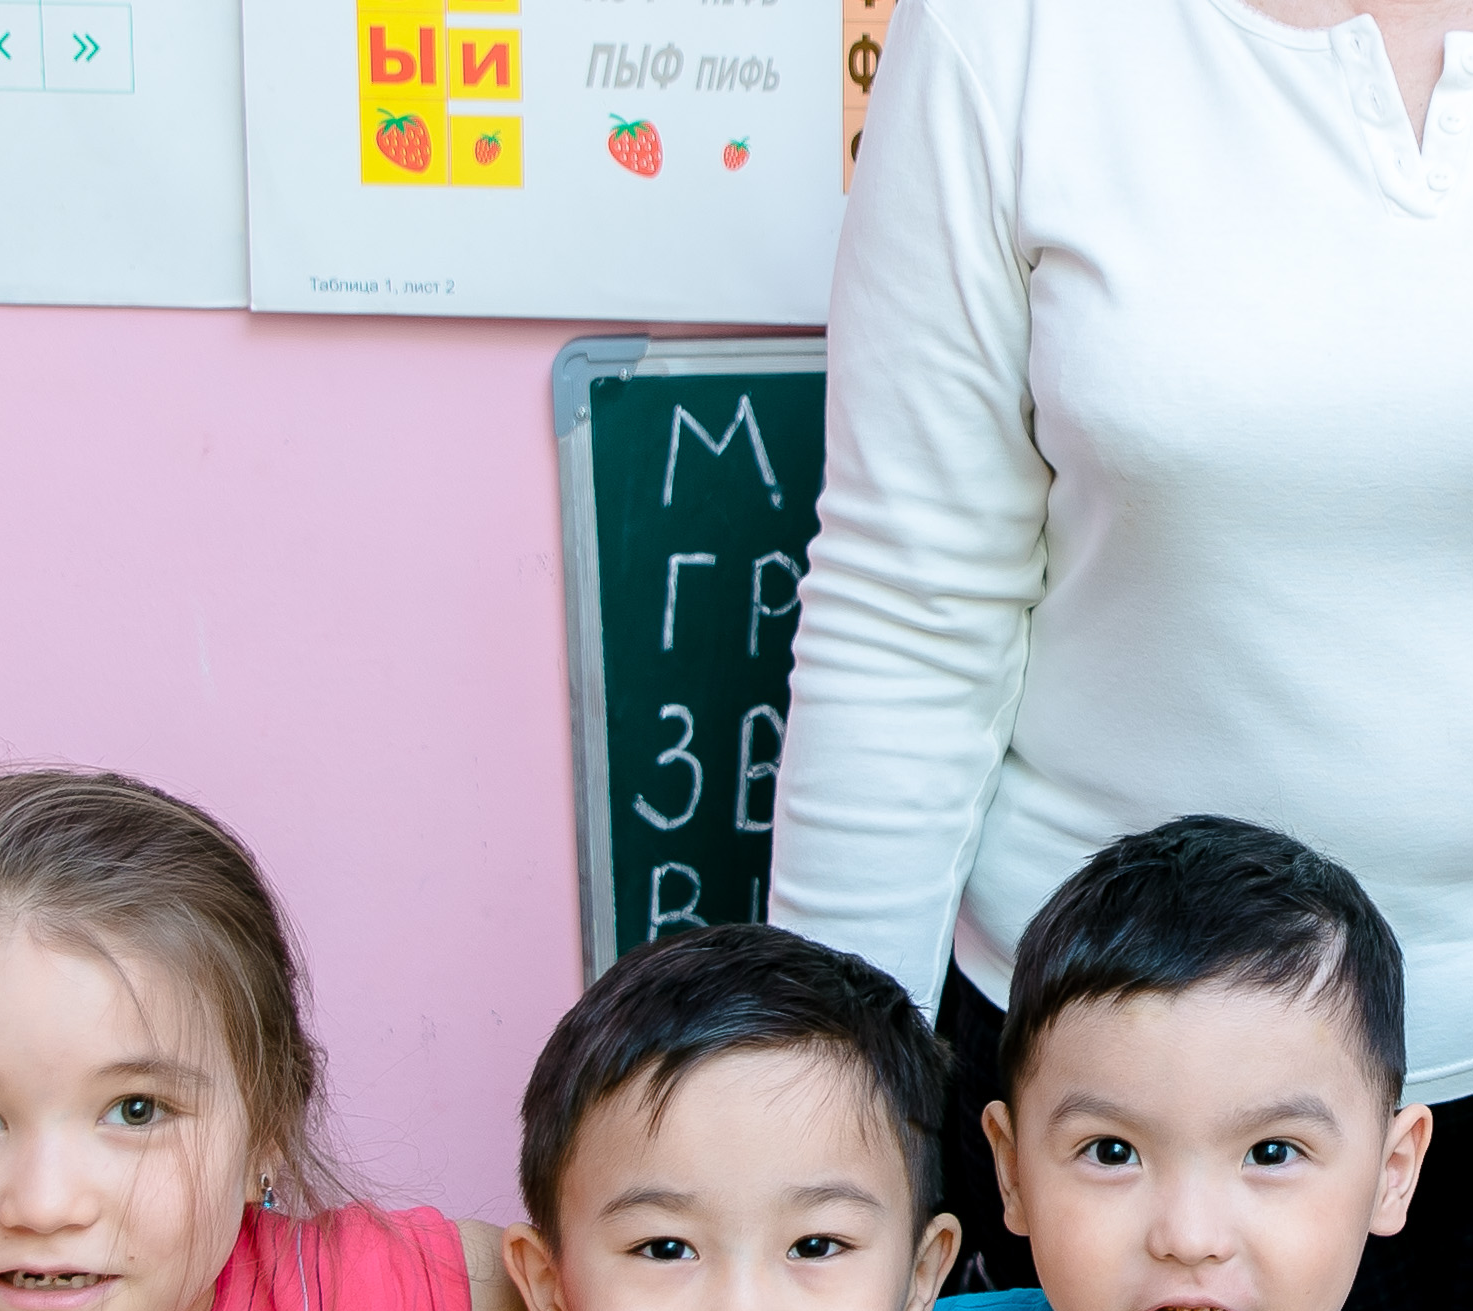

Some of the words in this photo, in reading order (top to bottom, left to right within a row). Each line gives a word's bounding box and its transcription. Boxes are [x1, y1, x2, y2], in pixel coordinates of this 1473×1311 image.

[310, 277, 379, 294] Таблица
[404, 281, 440, 294] лист
[446, 279, 455, 294] 2
